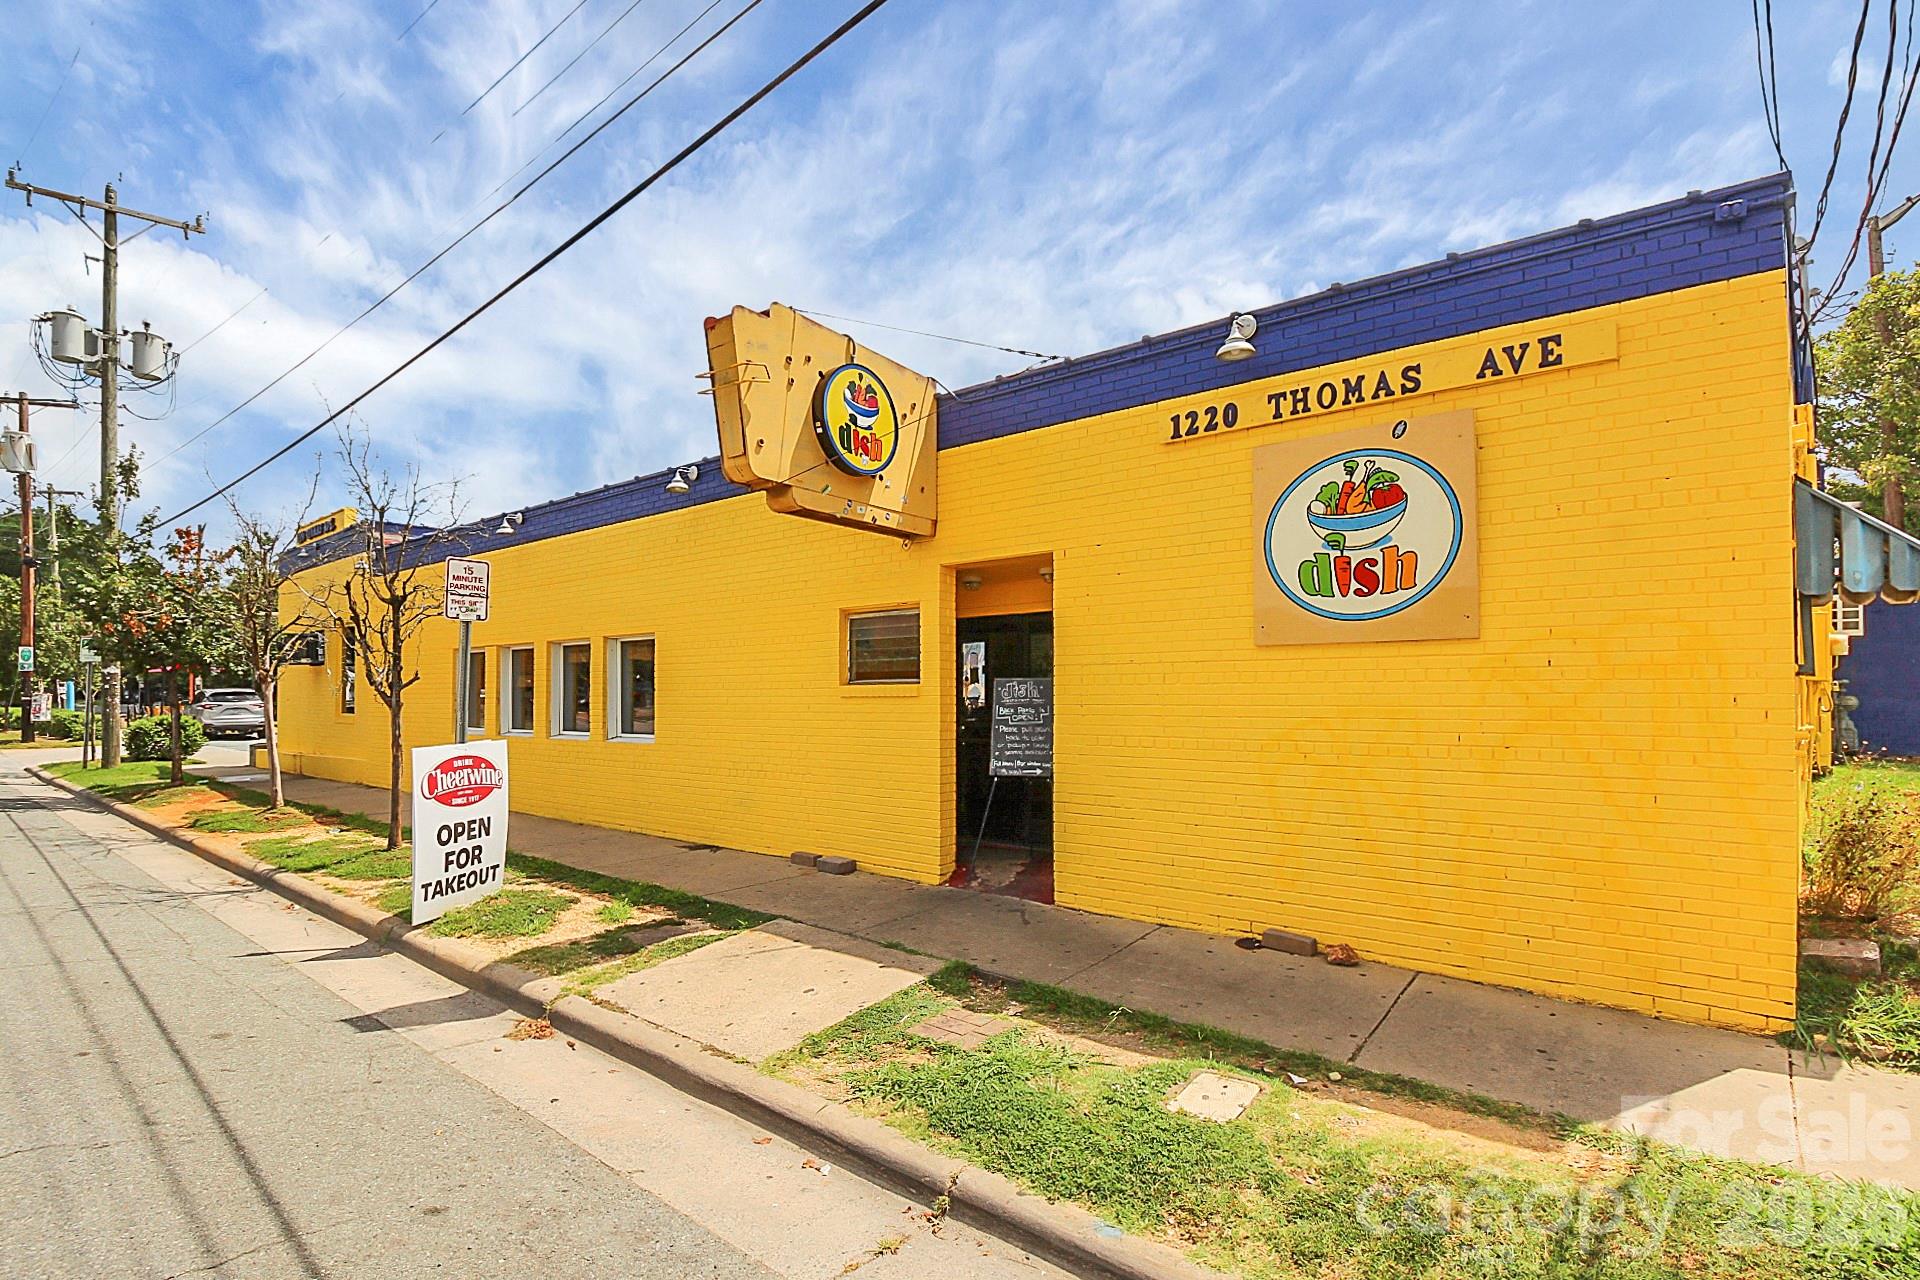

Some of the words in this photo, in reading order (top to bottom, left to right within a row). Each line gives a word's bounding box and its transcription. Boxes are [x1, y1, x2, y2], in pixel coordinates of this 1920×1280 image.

[1170, 402, 1238, 440] 1220
[1267, 363, 1422, 420] THOMAS
[1476, 334, 1563, 380] AVE
[839, 422, 883, 461] dish
[452, 574, 483, 583] MINUTE
[463, 566, 474, 575] 15
[1297, 543, 1418, 599] dish
[449, 582, 486, 592] PARKING
[450, 598, 465, 606] THIS
[1002, 681, 1040, 699] dish
[421, 763, 503, 800] Cheerwine
[437, 816, 491, 846] OPEN
[444, 845, 483, 873] FOR
[421, 864, 500, 902] TAKEOUT
